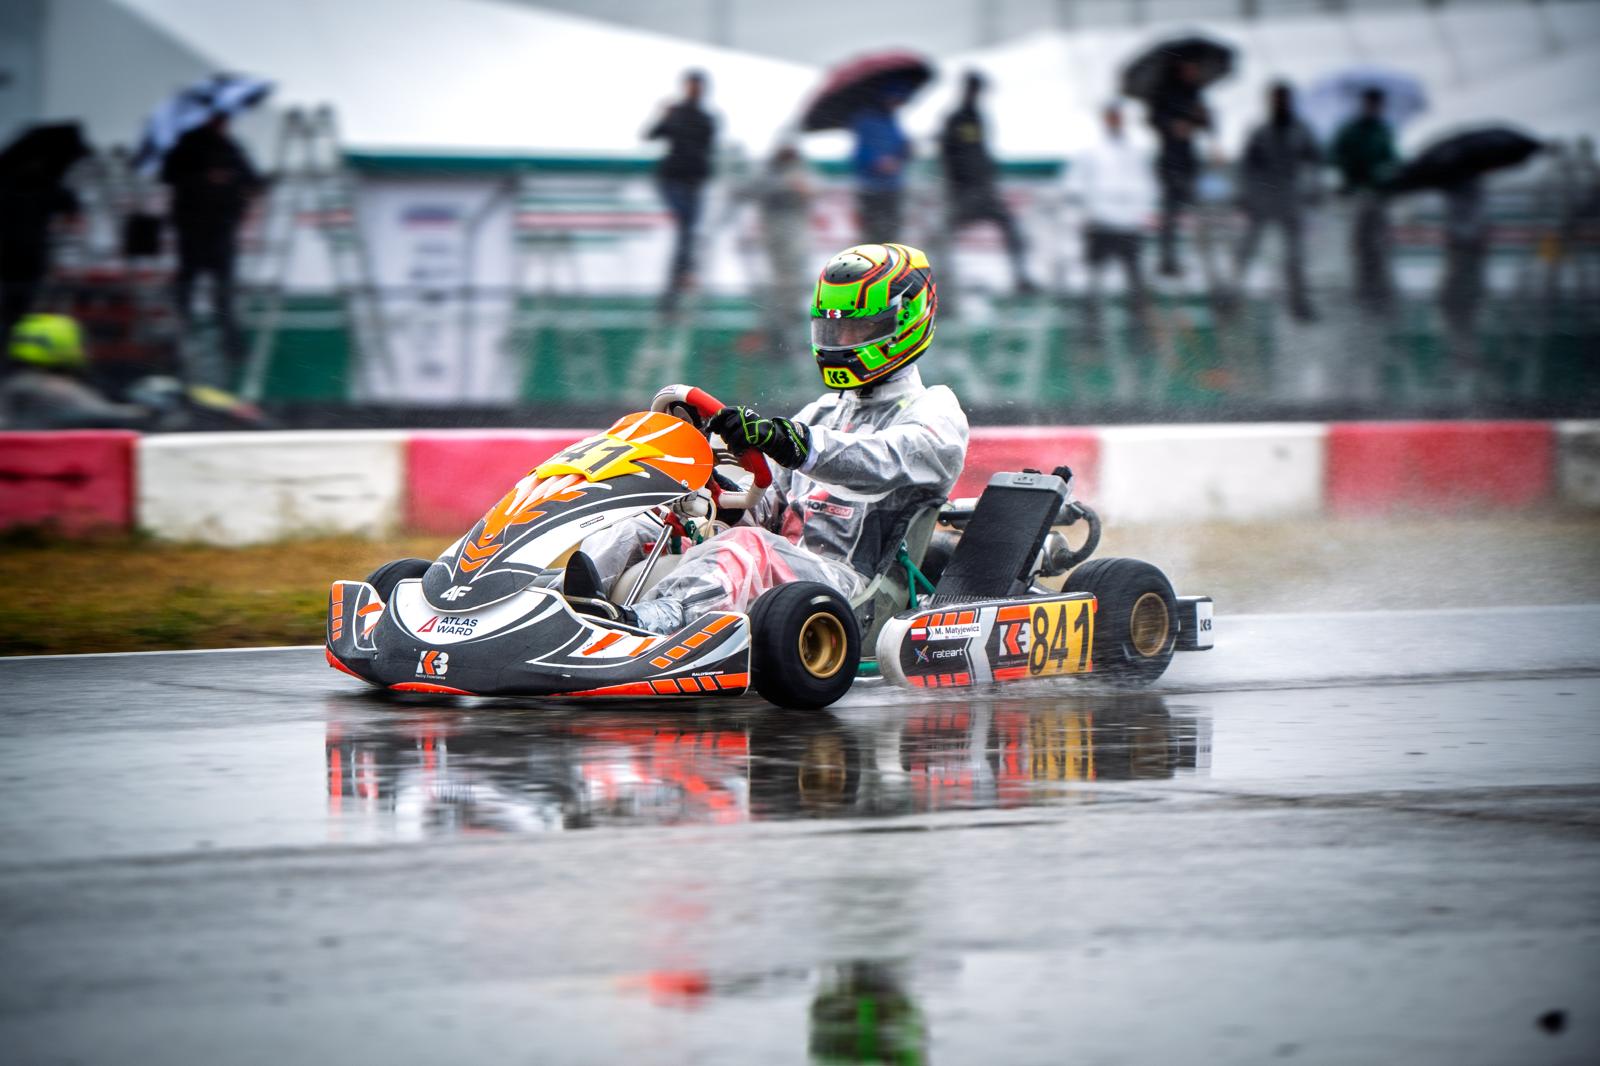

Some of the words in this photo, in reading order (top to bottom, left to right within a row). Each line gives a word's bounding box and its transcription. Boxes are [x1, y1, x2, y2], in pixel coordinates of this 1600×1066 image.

[545, 438, 634, 474] 41
[440, 616, 479, 627] ATLAS
[436, 625, 473, 636] WARD
[935, 627, 944, 635] M.
[945, 624, 980, 637] Matyjewicz
[1029, 602, 1090, 675] 841
[932, 647, 964, 659] rateart
